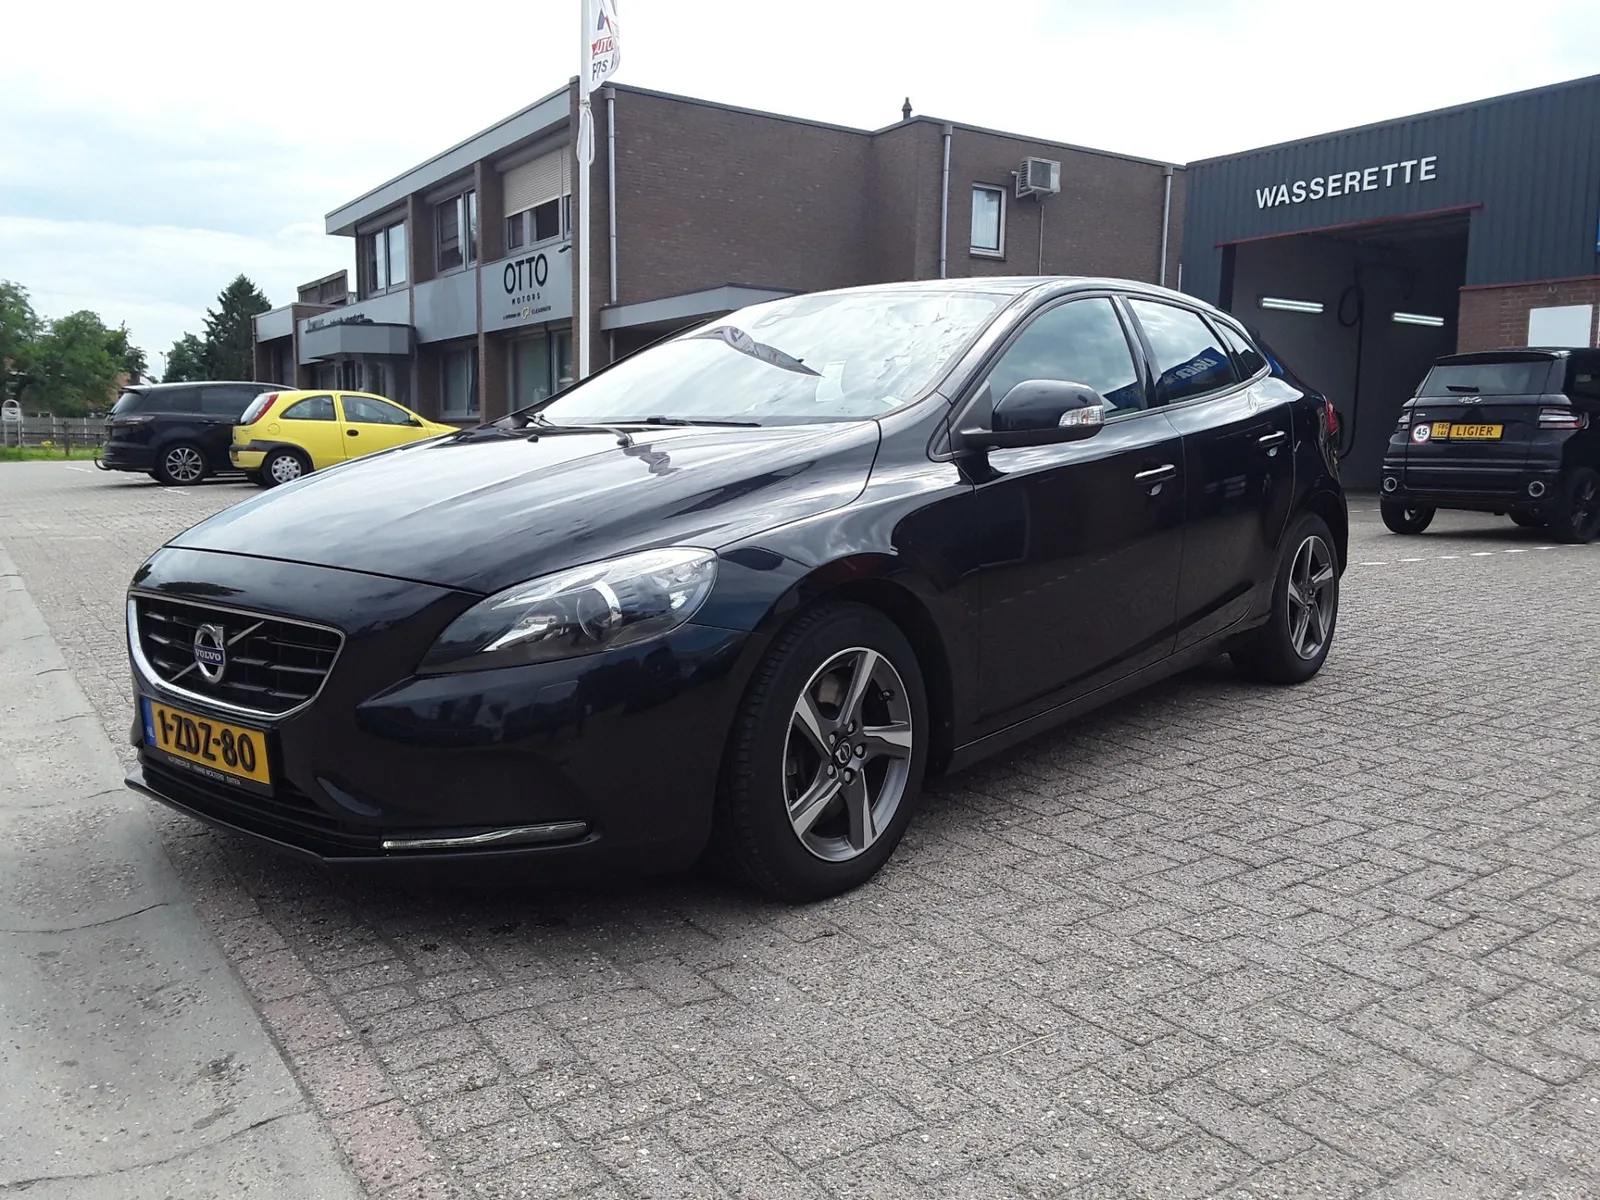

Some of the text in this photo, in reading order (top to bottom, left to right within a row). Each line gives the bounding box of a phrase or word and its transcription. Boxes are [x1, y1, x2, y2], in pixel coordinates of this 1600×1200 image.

[1256, 156, 1437, 209] WASSERETTE
[503, 253, 548, 295] OTTO
[512, 292, 541, 304] MOTORS
[1415, 427, 1428, 436] 45
[1456, 426, 1494, 436] LIGIER
[195, 648, 221, 661] VOLVO
[158, 709, 256, 773] 1-ZDZ-80
